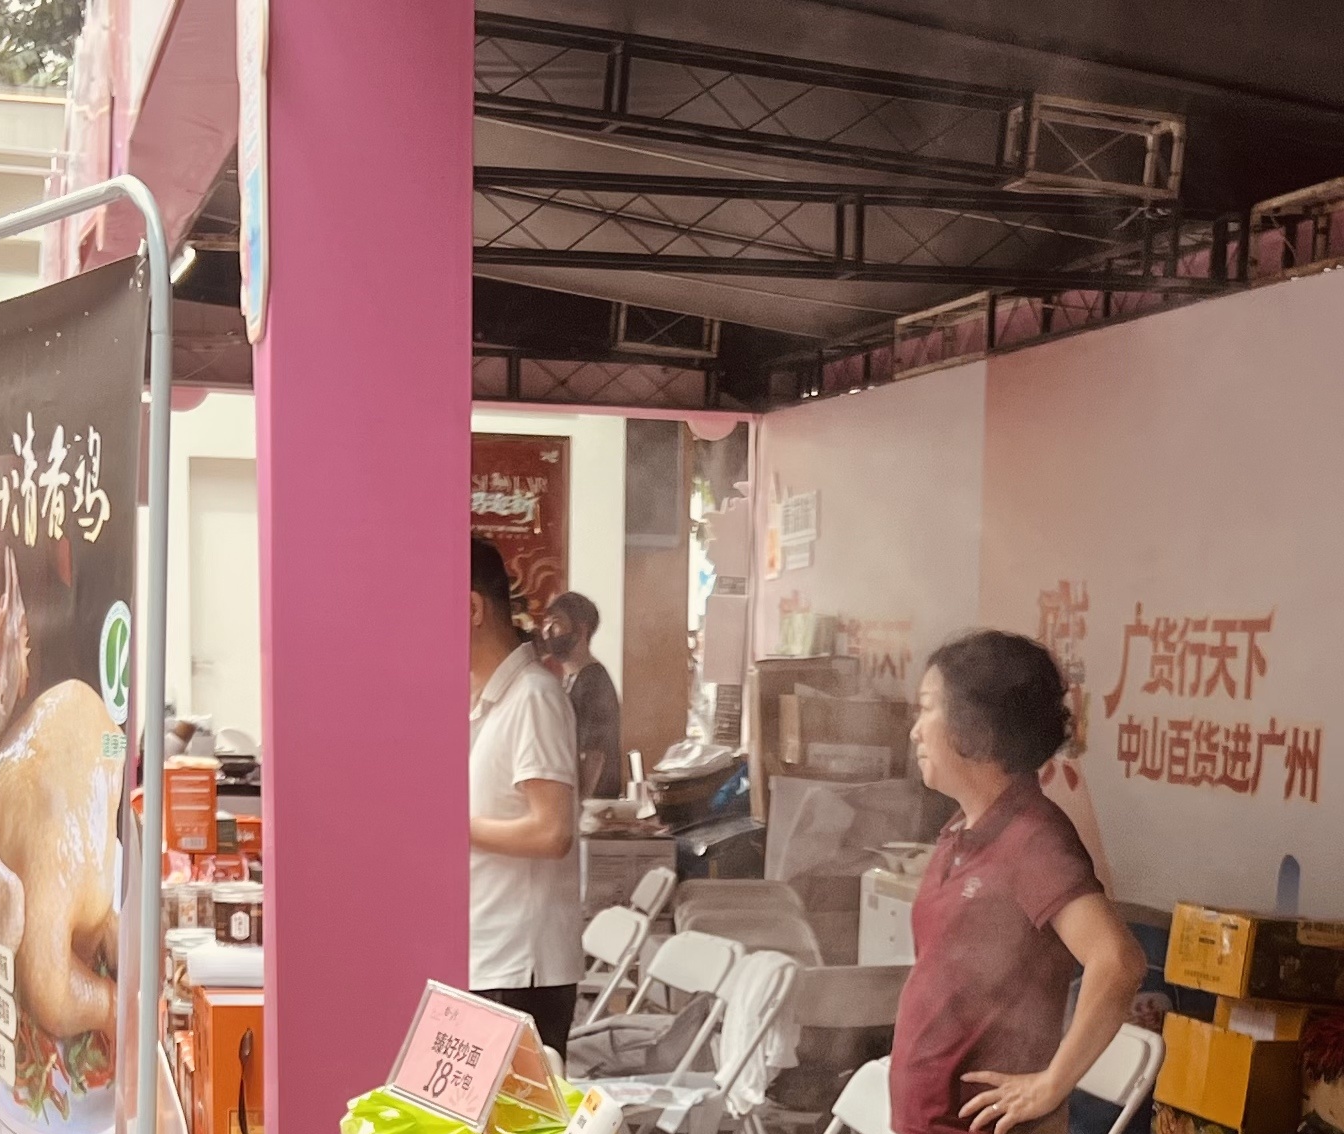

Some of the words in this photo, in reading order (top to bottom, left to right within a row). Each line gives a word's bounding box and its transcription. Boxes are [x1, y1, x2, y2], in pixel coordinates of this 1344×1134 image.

[1103, 601, 1277, 719] 广货行天下
[1117, 714, 1322, 803] 中山百货进广州
